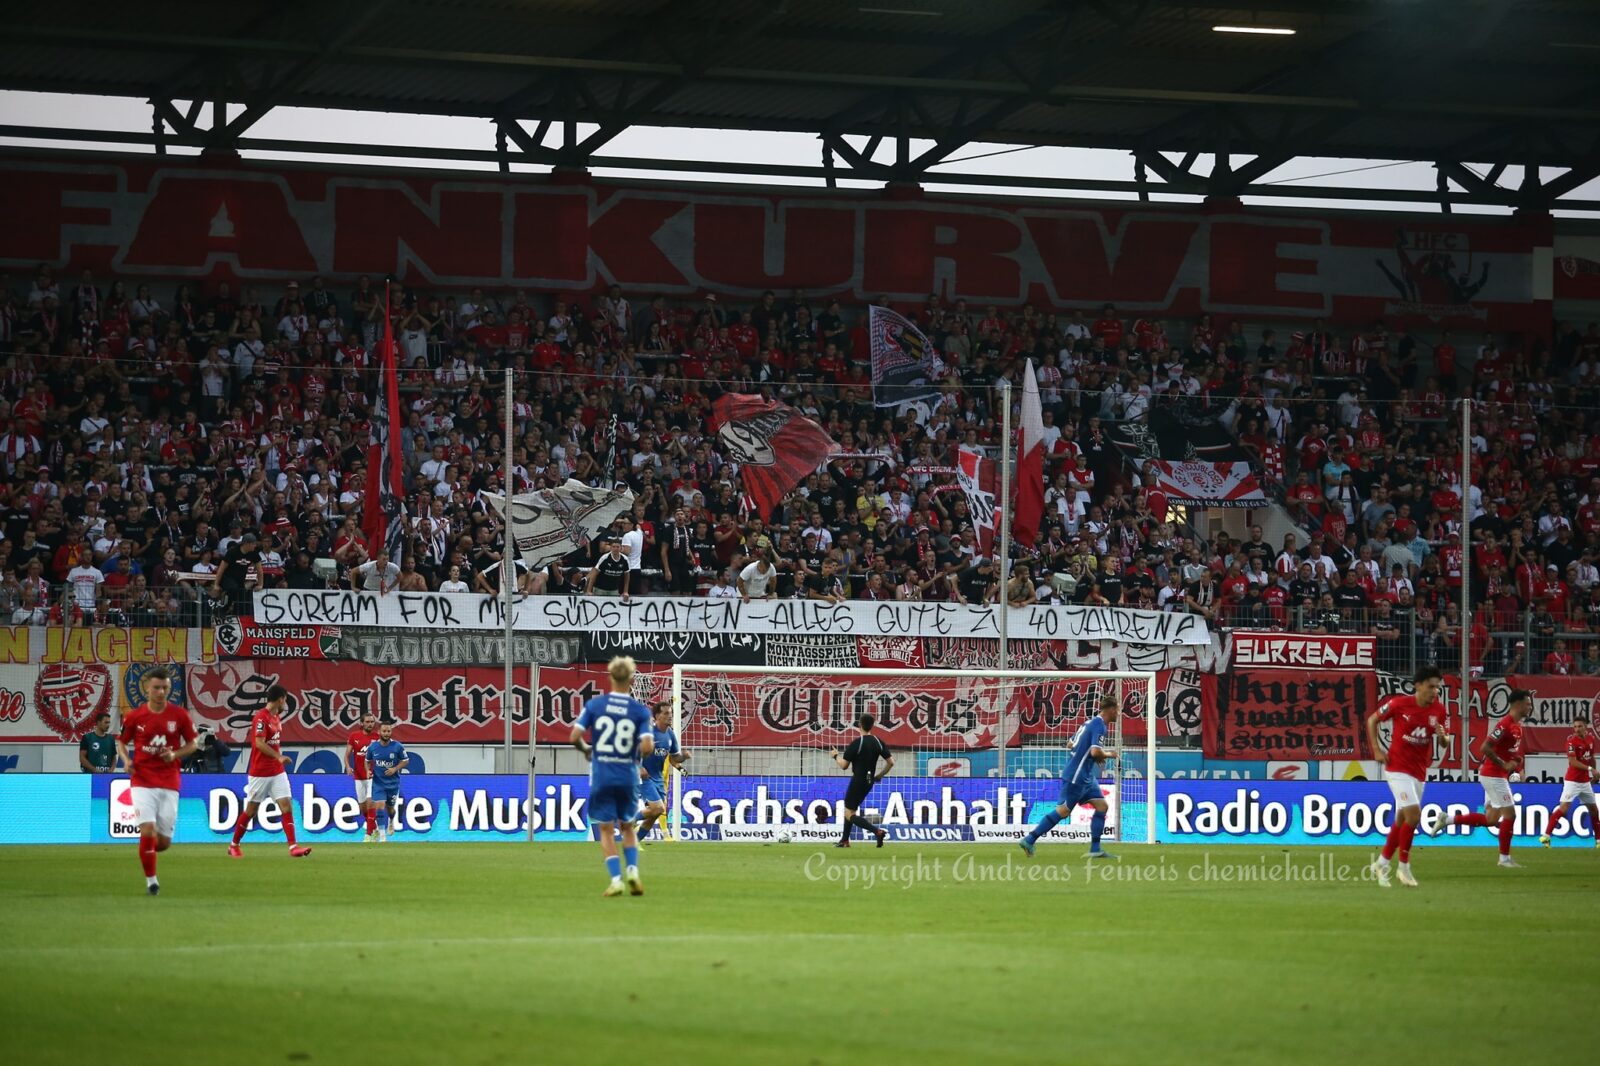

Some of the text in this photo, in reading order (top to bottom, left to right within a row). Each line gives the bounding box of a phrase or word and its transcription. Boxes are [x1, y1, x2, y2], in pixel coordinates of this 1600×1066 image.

[0, 163, 1333, 319] FANKURVE
[261, 592, 379, 624] SCREAM
[398, 594, 460, 624] FOR
[876, 603, 957, 635] GUTE
[1029, 607, 1058, 635] 40
[42, 627, 188, 663] JAGEN
[246, 627, 316, 640] MANSFELD
[252, 641, 310, 657] SÜDHARZ
[767, 643, 857, 659] MONTAGSSPIELE
[767, 655, 795, 667] NICHT
[1236, 639, 1373, 666] SURREALE
[1180, 671, 1200, 685] HF
[755, 681, 979, 735] Ultras
[1524, 690, 1591, 725] Leuna
[595, 715, 636, 754] 28
[447, 785, 587, 831] Musik
[1168, 789, 1287, 834] Radio
[1303, 793, 1470, 836] Brocen
[725, 828, 774, 839] bewegt
[897, 828, 963, 840] UNION
[978, 829, 1025, 840] bewegt
